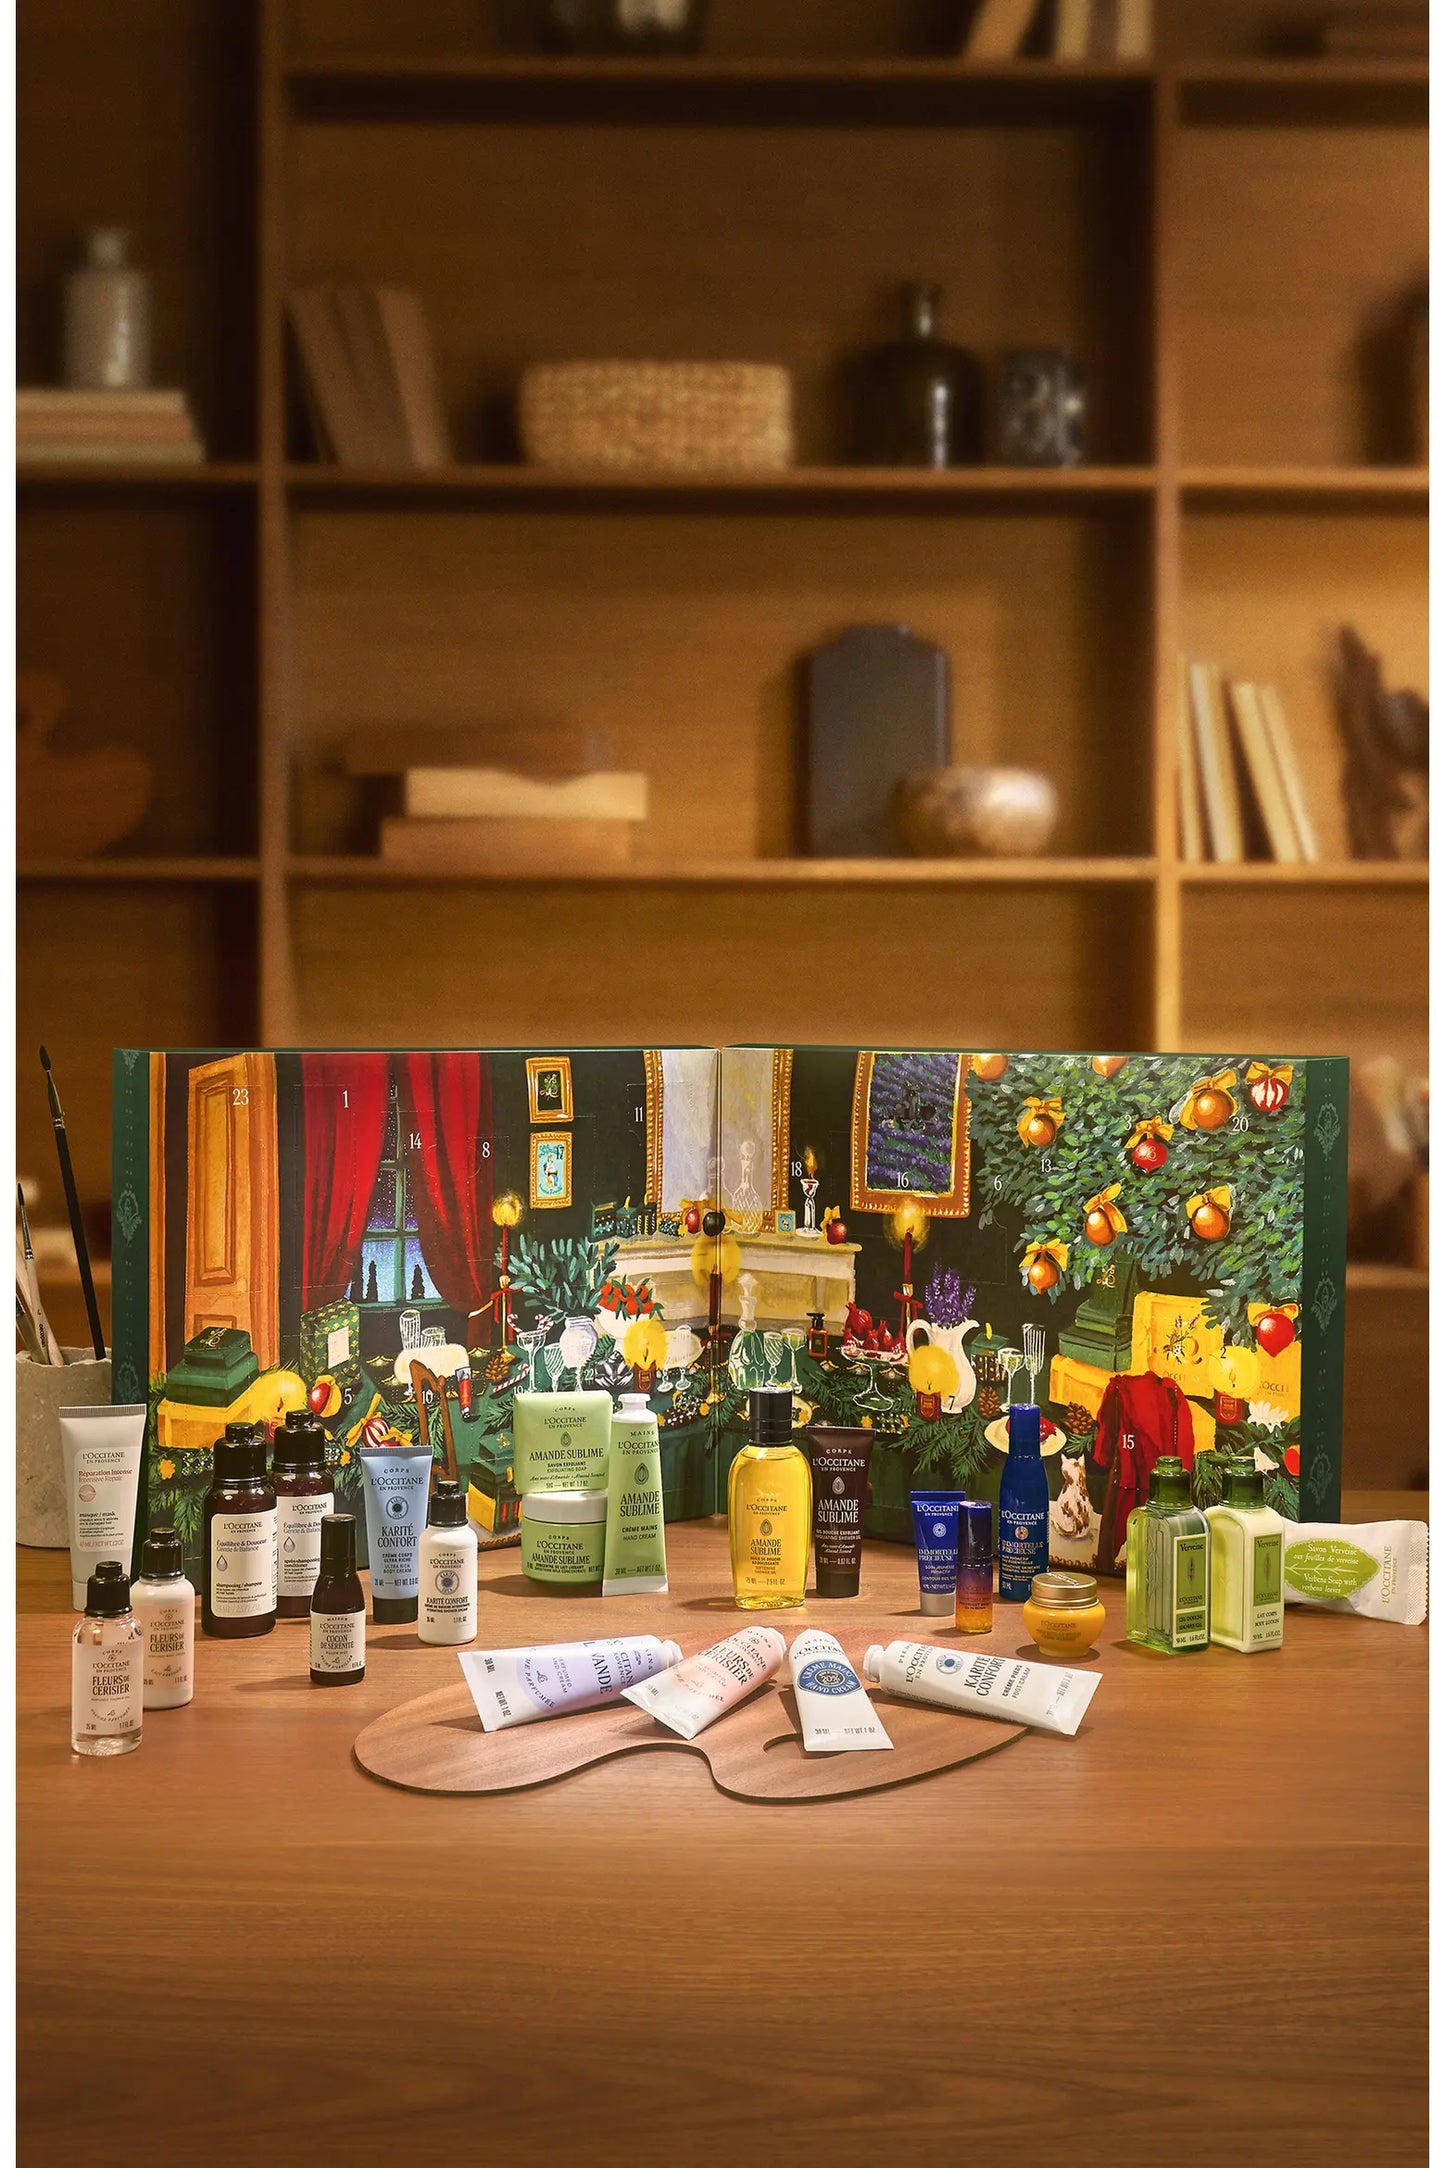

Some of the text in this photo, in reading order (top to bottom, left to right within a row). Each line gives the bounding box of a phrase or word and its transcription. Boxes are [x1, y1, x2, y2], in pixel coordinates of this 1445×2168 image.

[233, 1088, 249, 1106] 23
[343, 1090, 349, 1108] 1
[635, 1107, 643, 1122] 11
[1124, 1115, 1132, 1131] 3
[1233, 1117, 1249, 1132] 20
[410, 1133, 422, 1149] 14
[482, 1142, 491, 1158] 8
[556, 1146, 564, 1160] 17
[791, 1161, 802, 1177] 18
[1041, 1158, 1051, 1173] 13
[896, 1172, 909, 1188] 16
[994, 1175, 1002, 1190] 6
[1220, 1347, 1227, 1359] 2
[344, 1388, 352, 1405] 5
[422, 1390, 433, 1405] 10
[948, 1395, 955, 1410] 7
[544, 1416, 587, 1425] L'OCCITANE
[1122, 1434, 1135, 1450] 15
[82, 1452, 125, 1460] L'OCCITANE
[529, 1448, 604, 1461] AMANDE SUBLIME
[812, 1456, 866, 1467] L'OCCITANE
[371, 1477, 424, 1486] L'OCCITANE
[620, 1491, 660, 1505] AMANDE
[619, 1503, 660, 1517] SUBLIME
[746, 1503, 788, 1511] L'OCCITANE
[818, 1499, 859, 1511] AMANDE
[817, 1510, 859, 1523] SUBLIME
[1001, 1510, 1045, 1520] L'OCCITANE
[223, 1521, 262, 1530] L'OCCITANE
[381, 1523, 414, 1537] KARITÉ
[622, 1524, 658, 1533] CRÈME MAINS
[377, 1537, 417, 1548] CONFORT
[639, 1532, 656, 1540] CREAM
[537, 1540, 584, 1551] L'OCCITANE
[751, 1539, 781, 1548] AMANDE
[1180, 1543, 1204, 1551] Verveine
[1257, 1540, 1279, 1548] Verveine
[1308, 1544, 1358, 1556] Savon Verveine
[750, 1546, 781, 1556] SUBLIME
[430, 1558, 464, 1566] L'OCCITANE
[531, 1552, 590, 1565] AMANDE SUBLIME
[1304, 1553, 1325, 1562] feuilles
[1336, 1557, 1359, 1565] verveine
[1304, 1573, 1357, 1586] Verbena Soap with
[1381, 1545, 1392, 1604] L'OCCITANE
[1302, 1584, 1323, 1592] verbena
[444, 1596, 468, 1605] CONFORT
[150, 1619, 185, 1628] L'OCCITANE
[320, 1622, 355, 1630] L'OCCITANE
[150, 1632, 179, 1643] FLEURS
[326, 1634, 348, 1642] COCON
[150, 1641, 185, 1653] CERISIER
[92, 1660, 130, 1669] L'OCCITANE
[964, 1656, 991, 1689] KARITÉ
[976, 1657, 1006, 1697] CONFORT
[1012, 1664, 1023, 1680] PIEDS
[92, 1674, 123, 1686] FLEURS
[92, 1682, 130, 1696] CERISIER
[805, 1679, 859, 1695] HAND CREAM
[1011, 1683, 1022, 1699] FOOT
